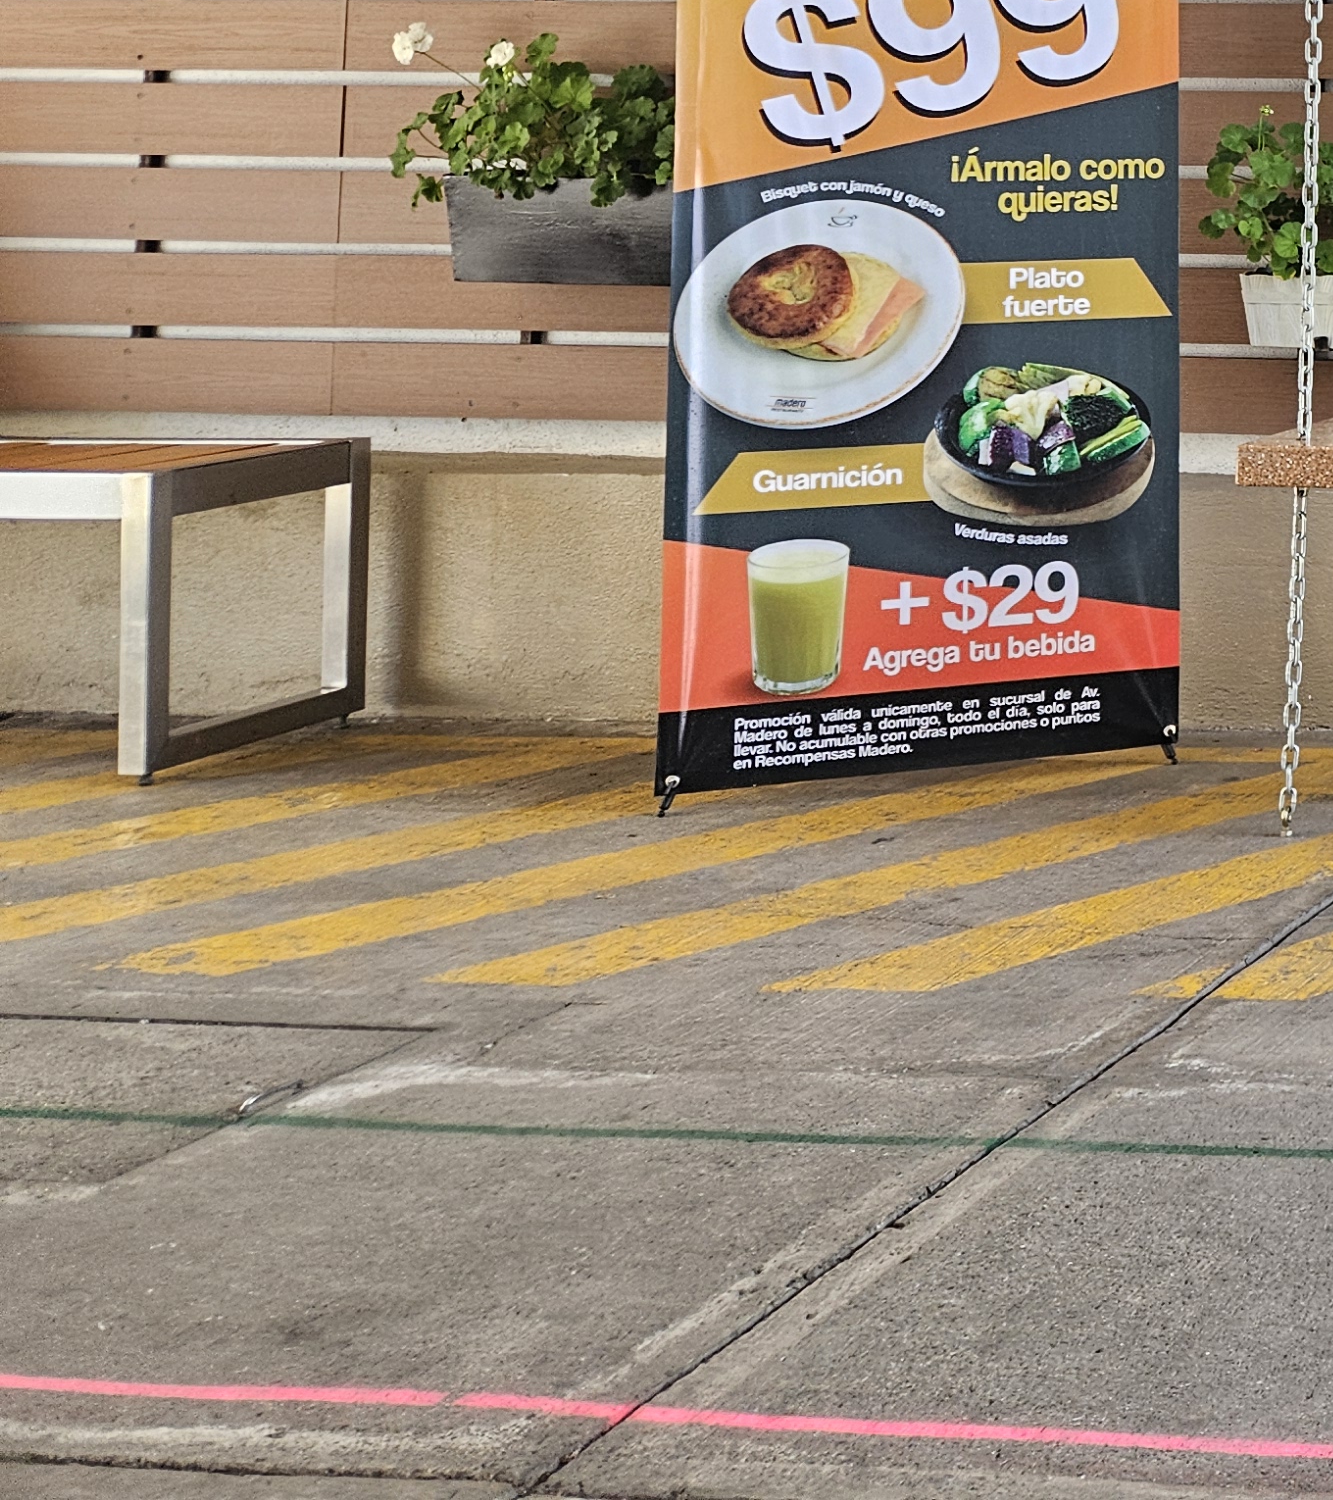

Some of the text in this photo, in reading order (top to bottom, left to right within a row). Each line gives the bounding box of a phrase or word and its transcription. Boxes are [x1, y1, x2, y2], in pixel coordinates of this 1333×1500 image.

[951, 147, 1165, 182] ¡Ármalo como
[760, 180, 945, 218] Bisquet con jamón y queso
[998, 184, 1118, 222] quieras!
[1009, 267, 1084, 289] Plato
[1002, 295, 1090, 317] fuerte
[752, 463, 904, 495] Guarnición
[954, 522, 1068, 545] Verduras asadas
[880, 560, 1080, 634] + $29
[863, 630, 1095, 676] Agrega tu bebida
[734, 686, 1100, 731] Promoción válida unicamente en sucursal de Av.
[734, 729, 788, 743] Madero
[794, 726, 813, 737] de
[819, 723, 856, 736] lunes
[863, 721, 872, 731] a
[878, 715, 941, 729] domingo,
[947, 710, 982, 723] todo
[988, 707, 1000, 719] el
[1036, 702, 1065, 715] solo
[1071, 699, 1100, 715] para
[734, 712, 1100, 757] llevar. No acumulable con otras promociones o puntos
[733, 743, 913, 770] en Recompensas Madero.
